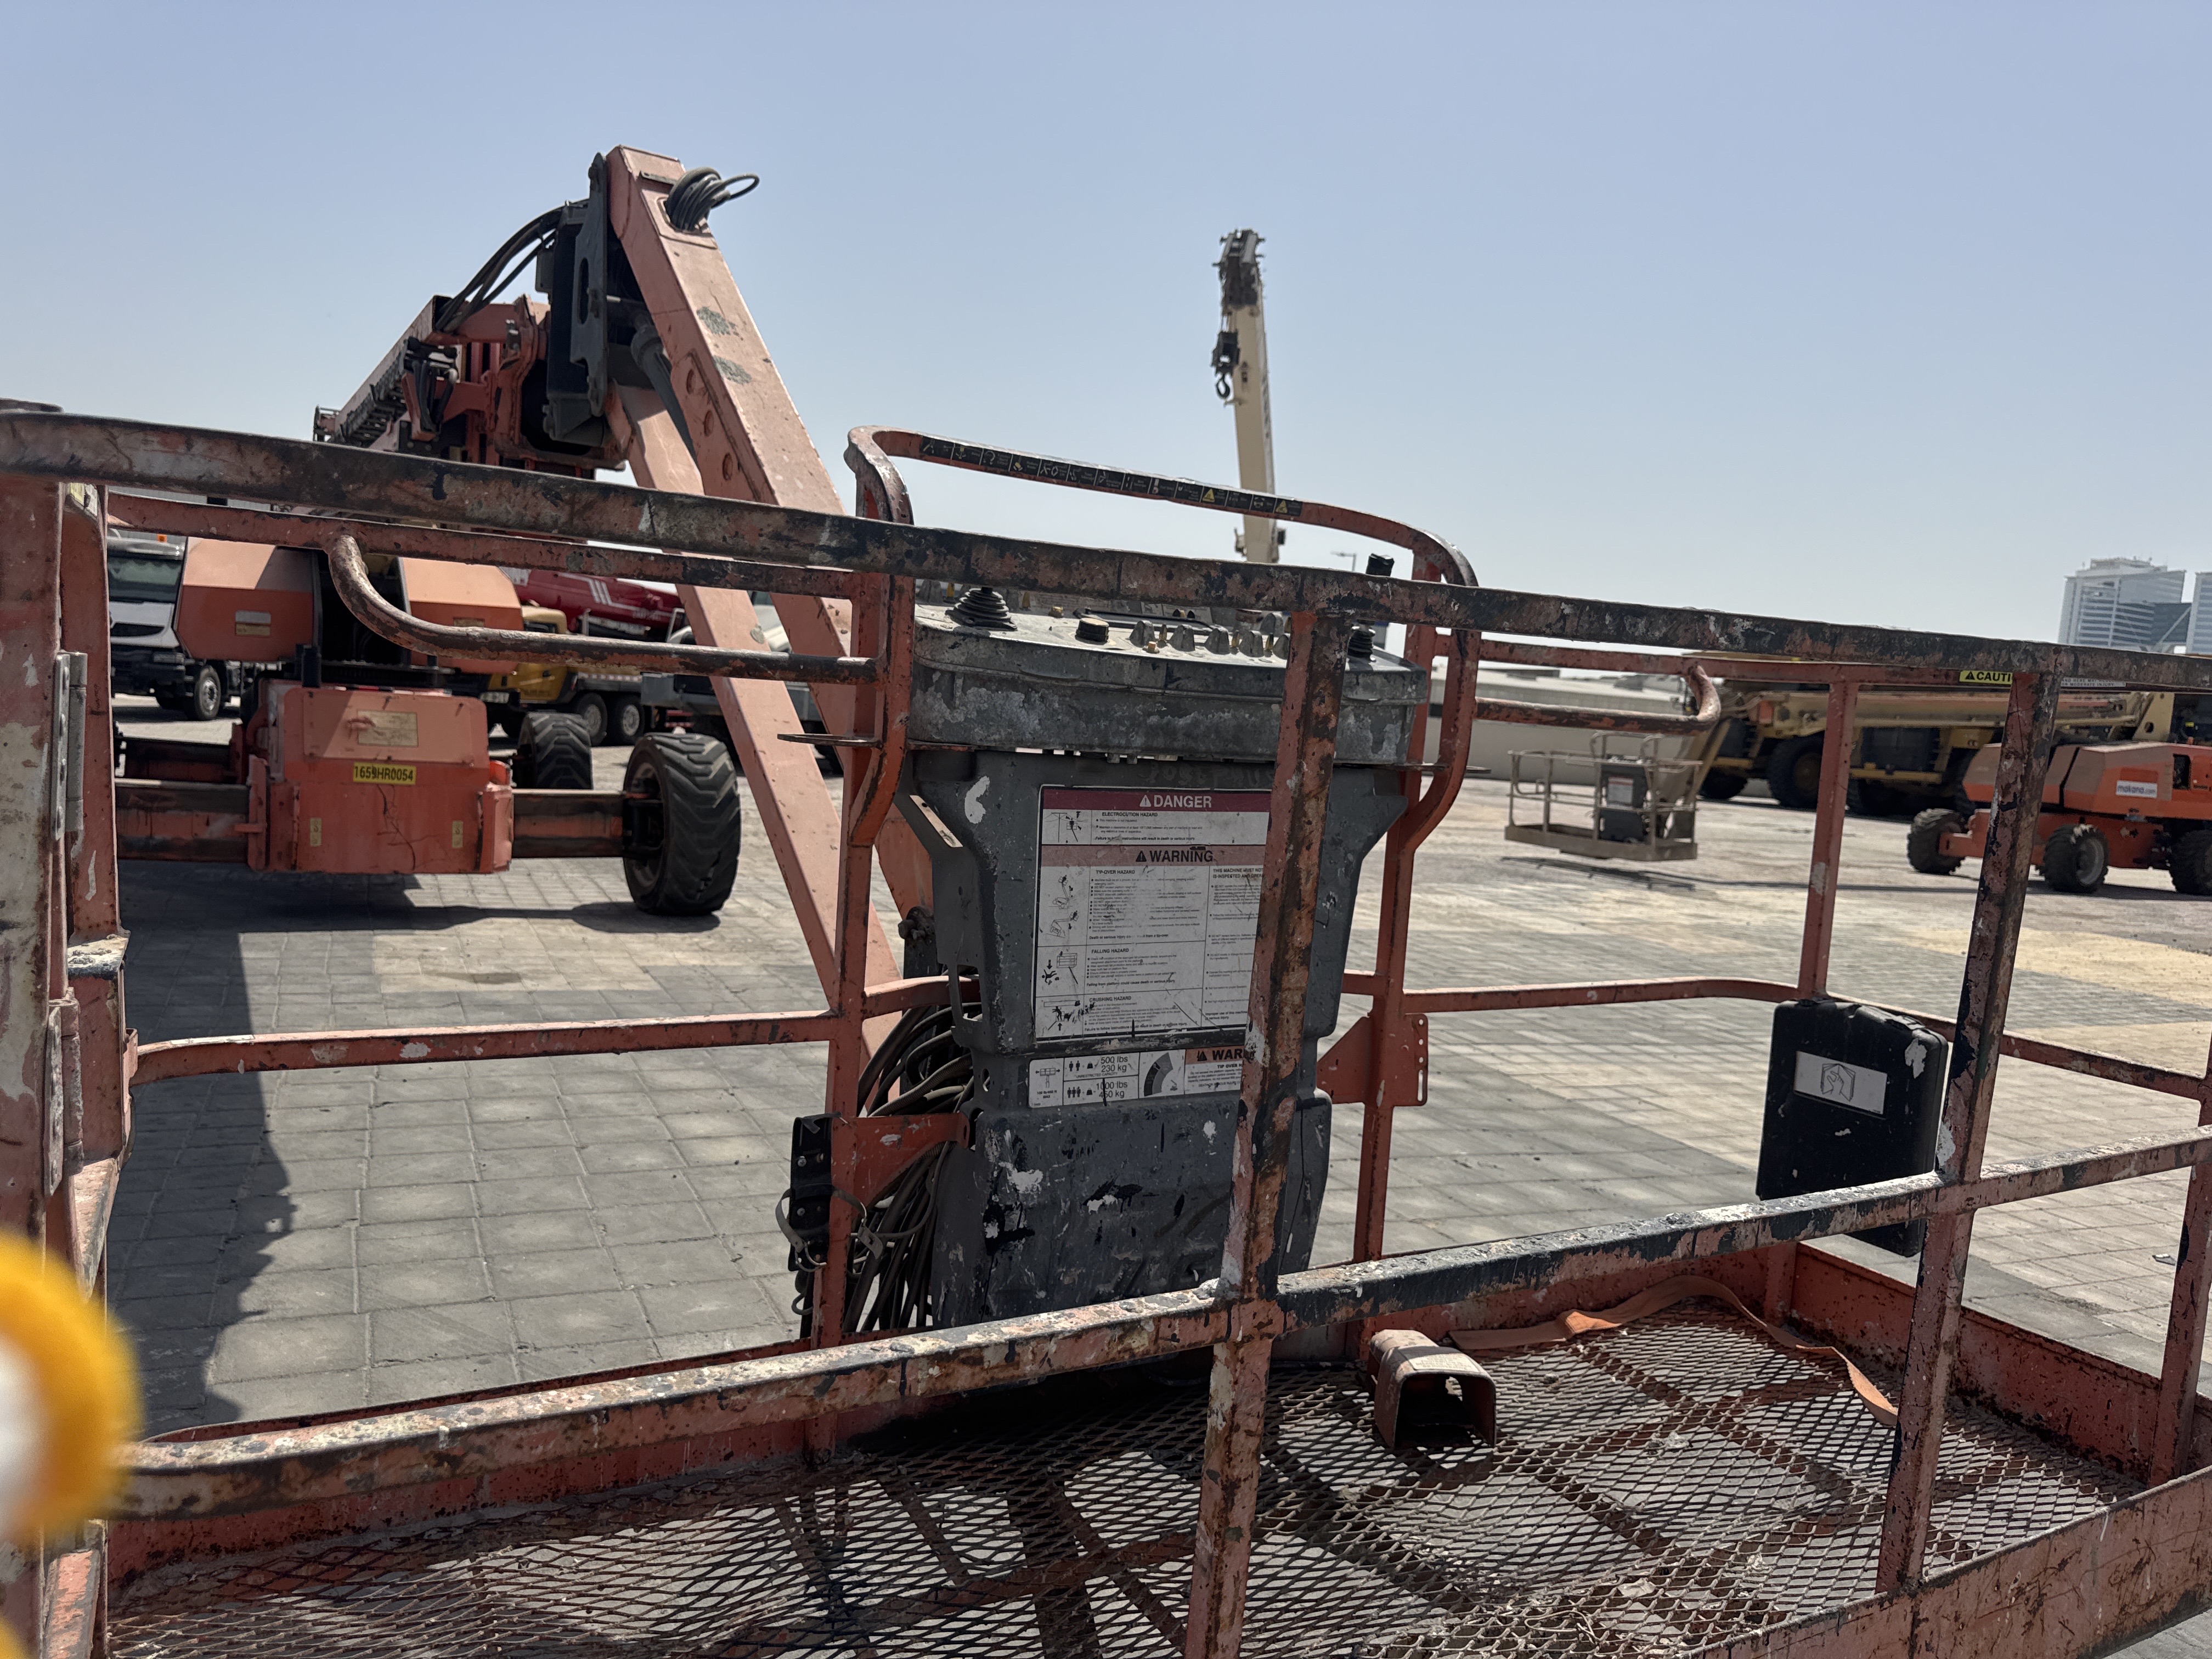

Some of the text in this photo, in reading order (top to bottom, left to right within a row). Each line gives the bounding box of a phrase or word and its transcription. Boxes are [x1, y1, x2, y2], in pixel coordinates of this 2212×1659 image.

[1976, 672, 2012, 681] CAUTI
[1154, 795, 1212, 808] DANGER
[1150, 850, 1214, 862] WARNING
[1212, 1048, 1243, 1060] WAR
[1118, 1064, 1127, 1073] kg
[1096, 1082, 1115, 1090] 1000
[1115, 1090, 1125, 1098] kg
